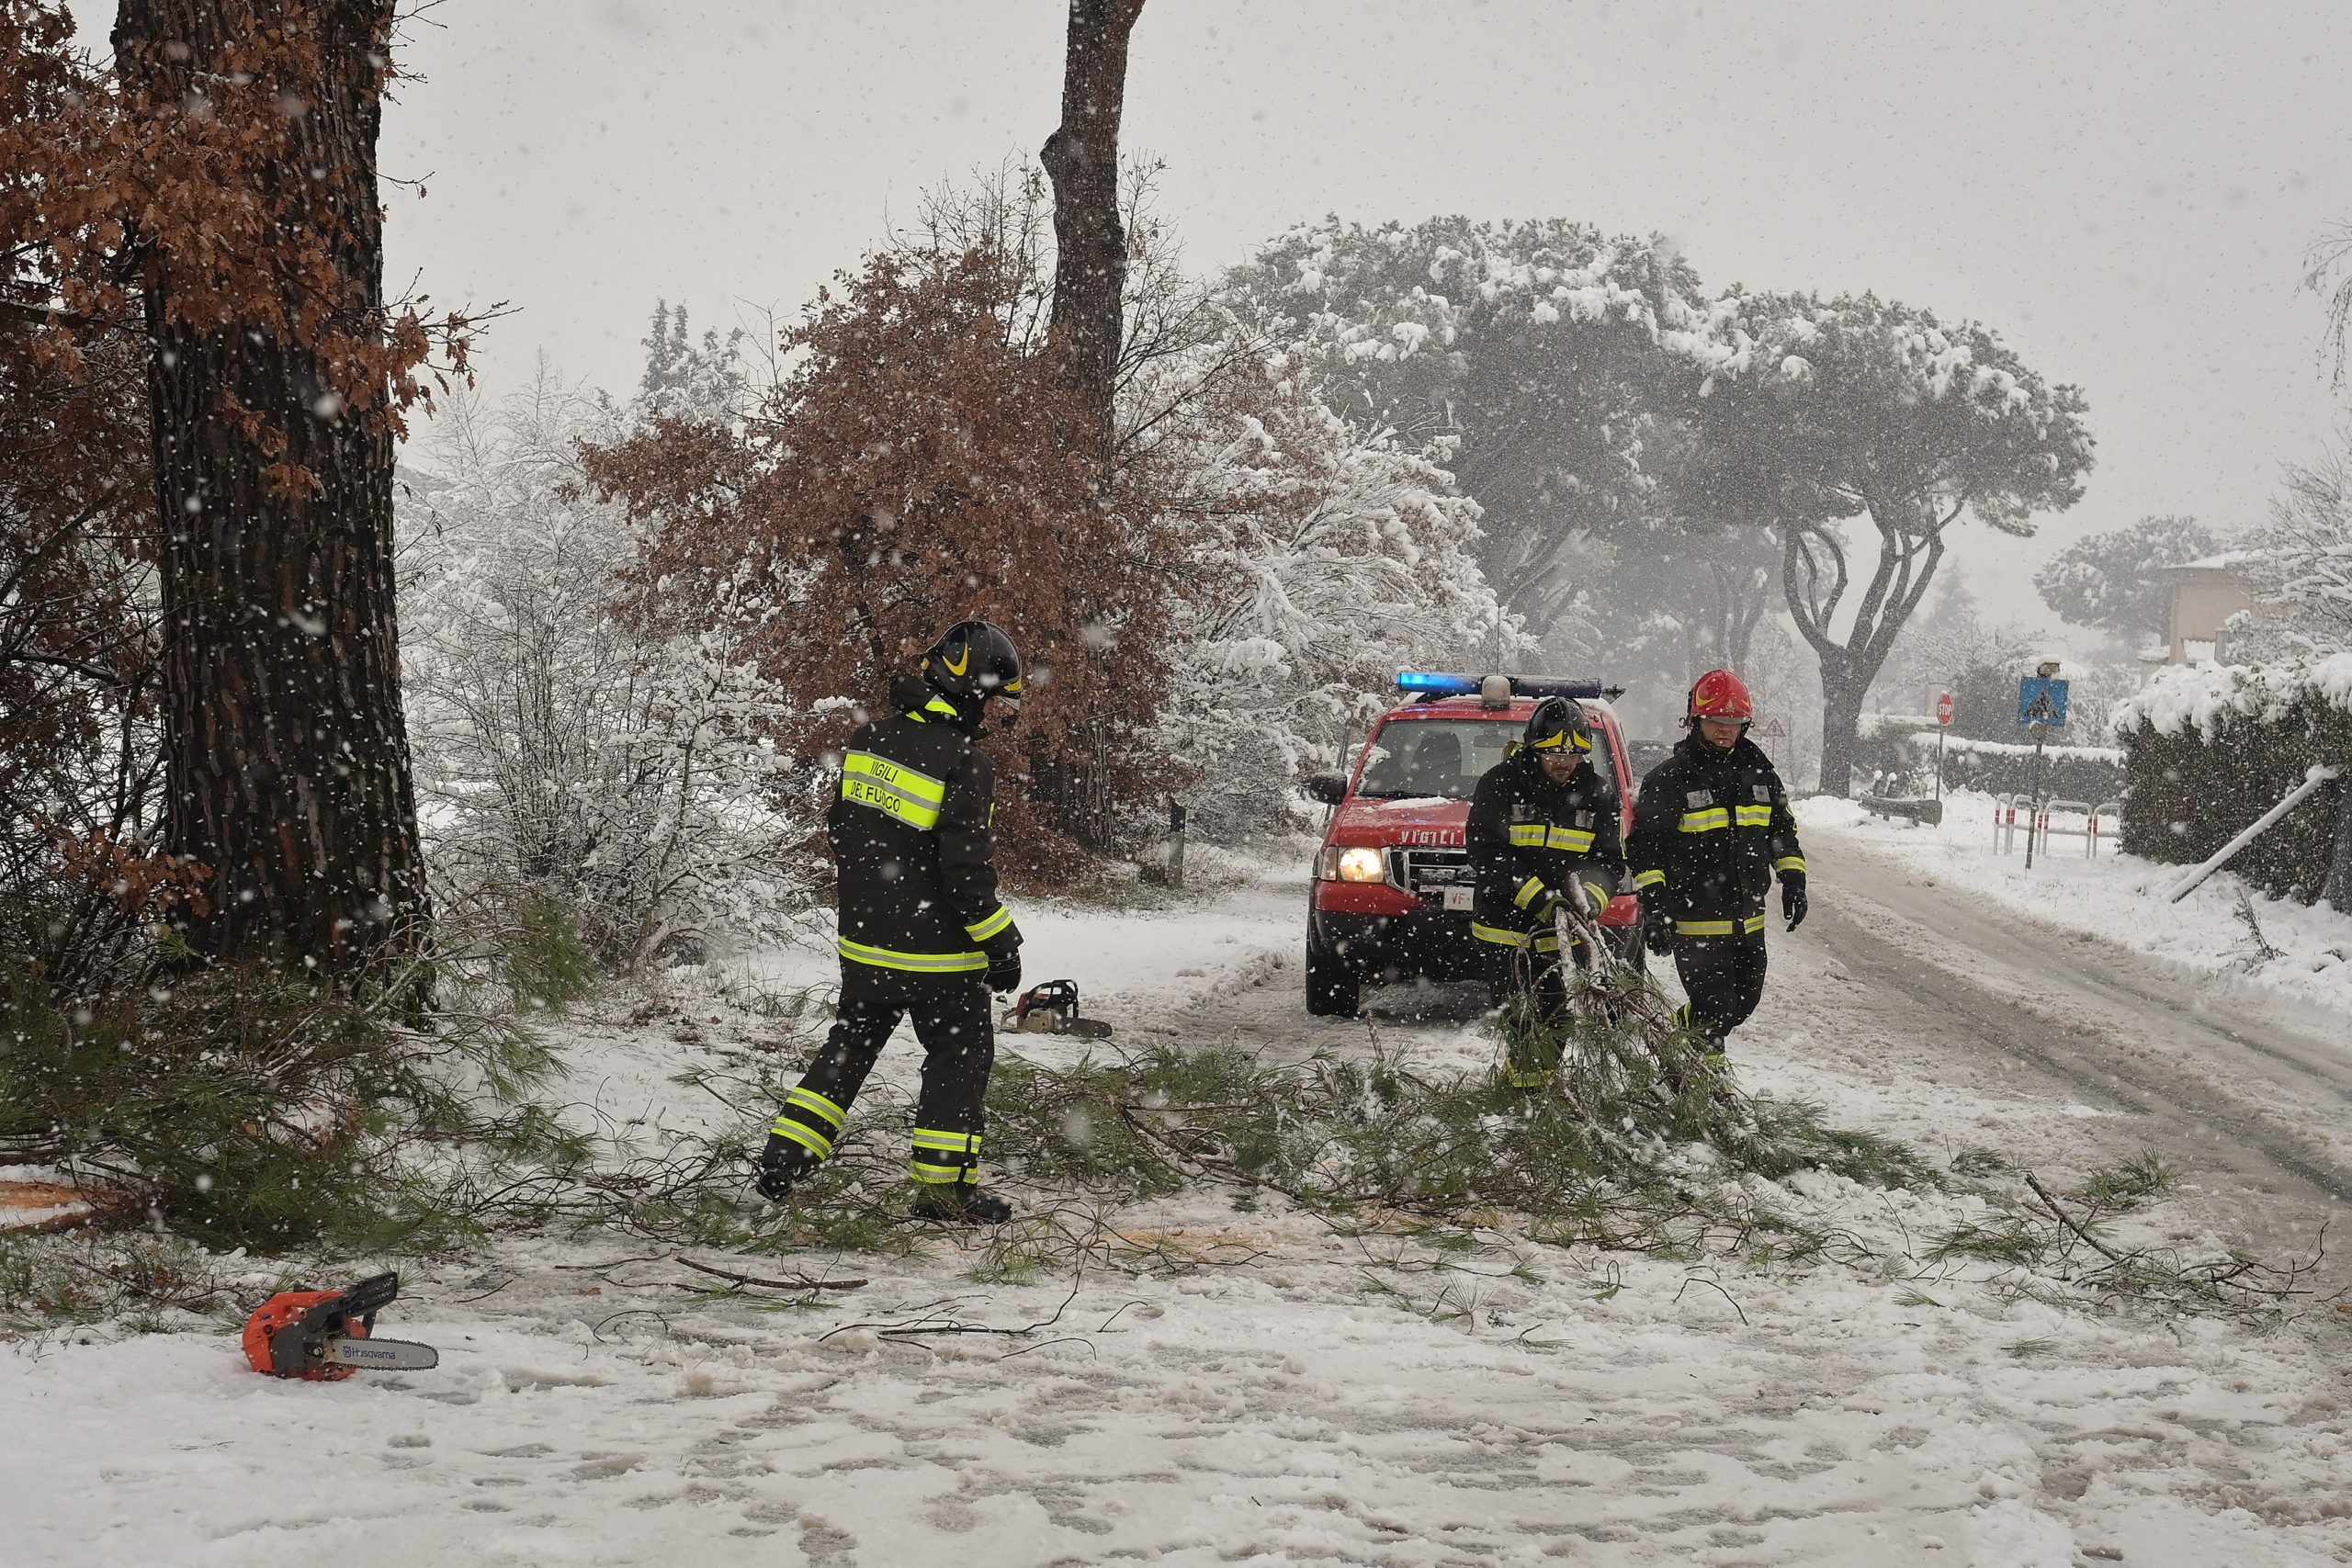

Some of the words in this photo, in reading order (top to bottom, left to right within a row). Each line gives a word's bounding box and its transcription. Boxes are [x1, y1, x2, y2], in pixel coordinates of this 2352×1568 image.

[1939, 704, 1951, 716] STOP
[869, 761, 898, 783] VIGILI
[851, 781, 863, 799] DEL
[865, 786, 900, 812] FUOCO
[1401, 830, 1455, 845] VIGILI
[1452, 893, 1464, 905] VF
[352, 1348, 396, 1359] Husqvarna
